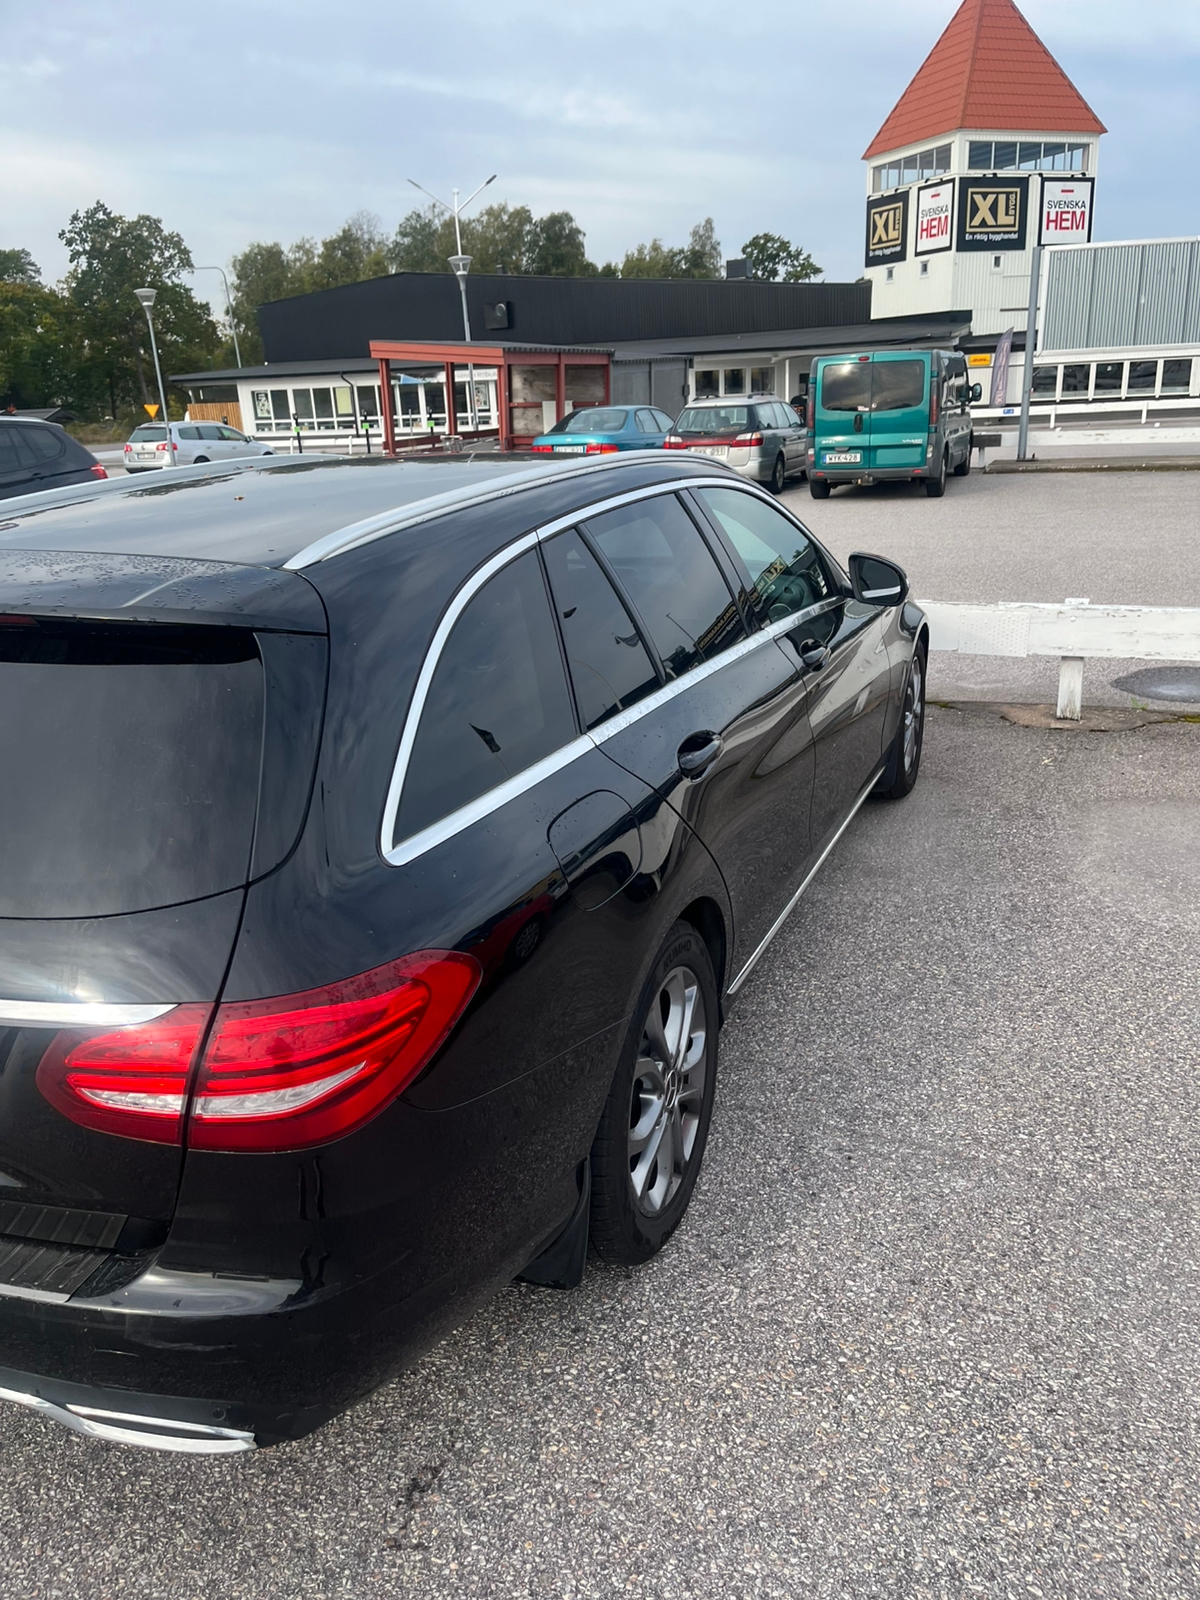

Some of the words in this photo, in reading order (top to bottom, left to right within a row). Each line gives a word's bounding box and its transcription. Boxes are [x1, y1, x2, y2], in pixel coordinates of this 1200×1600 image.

[920, 204, 949, 219] SVENSKA
[970, 194, 1014, 226] XL
[1008, 192, 1016, 215] BYGG
[1046, 200, 1086, 209] SVENSKA
[872, 210, 900, 244] XL
[920, 215, 949, 240] HEM
[1046, 211, 1086, 230] HEM
[663, 940, 692, 972] KUMHO
